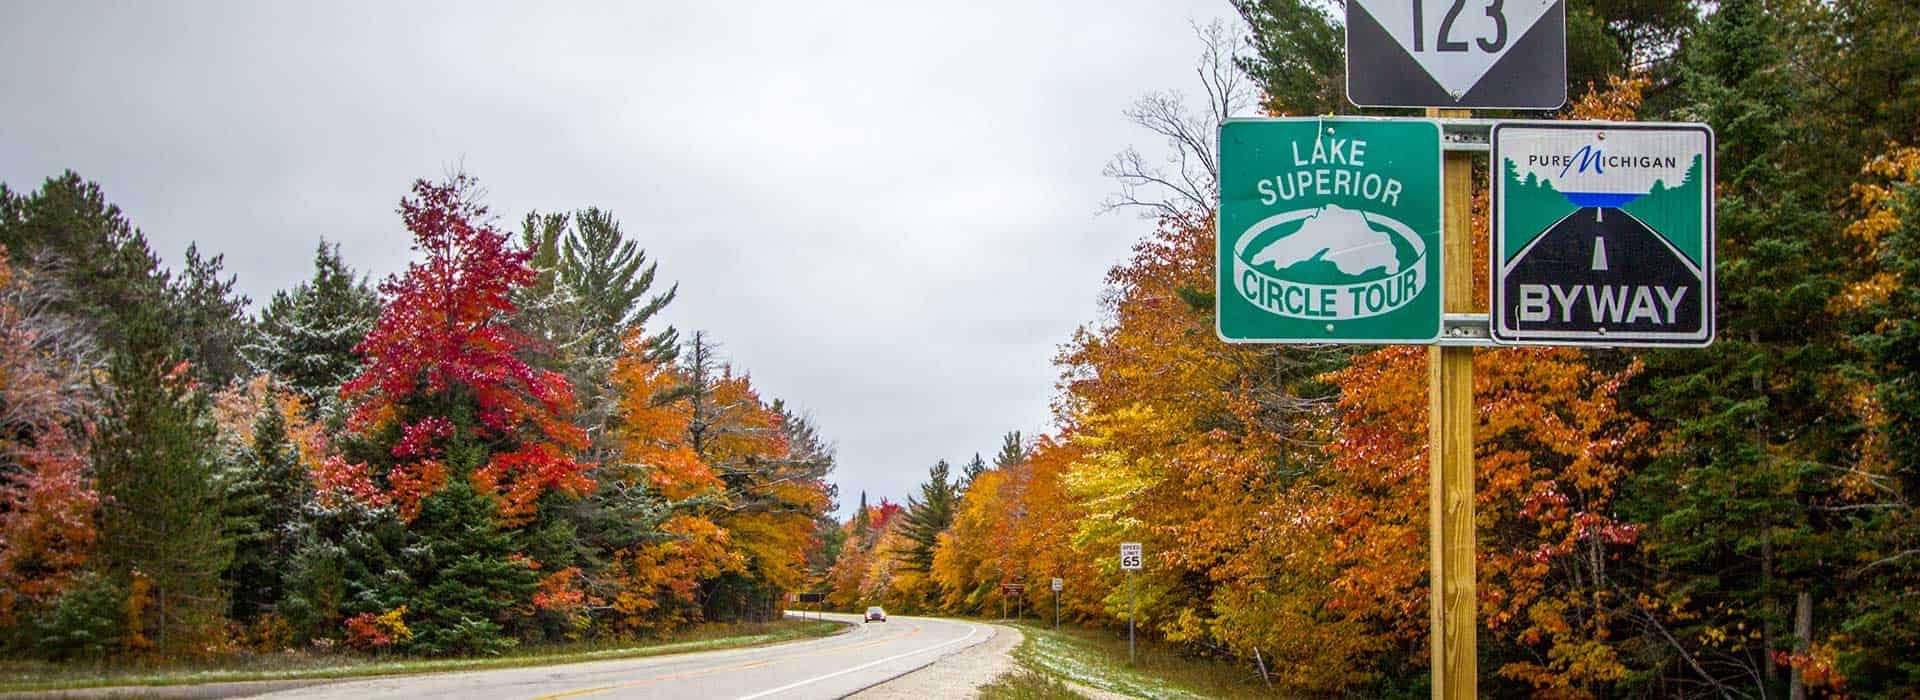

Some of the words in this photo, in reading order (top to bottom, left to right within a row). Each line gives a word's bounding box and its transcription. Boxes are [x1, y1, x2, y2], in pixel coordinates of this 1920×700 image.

[1412, 0, 1507, 53] 123
[1292, 139, 1367, 167] LAKE
[1529, 155, 1570, 167] PURE
[1560, 145, 1676, 178] MICHIGAN
[1258, 169, 1402, 206] SUPERIOR
[1243, 269, 1337, 317] CIRCLE
[1348, 268, 1417, 315] TOUR
[1520, 284, 1688, 324] BYWAY
[1123, 556, 1140, 566] 65
